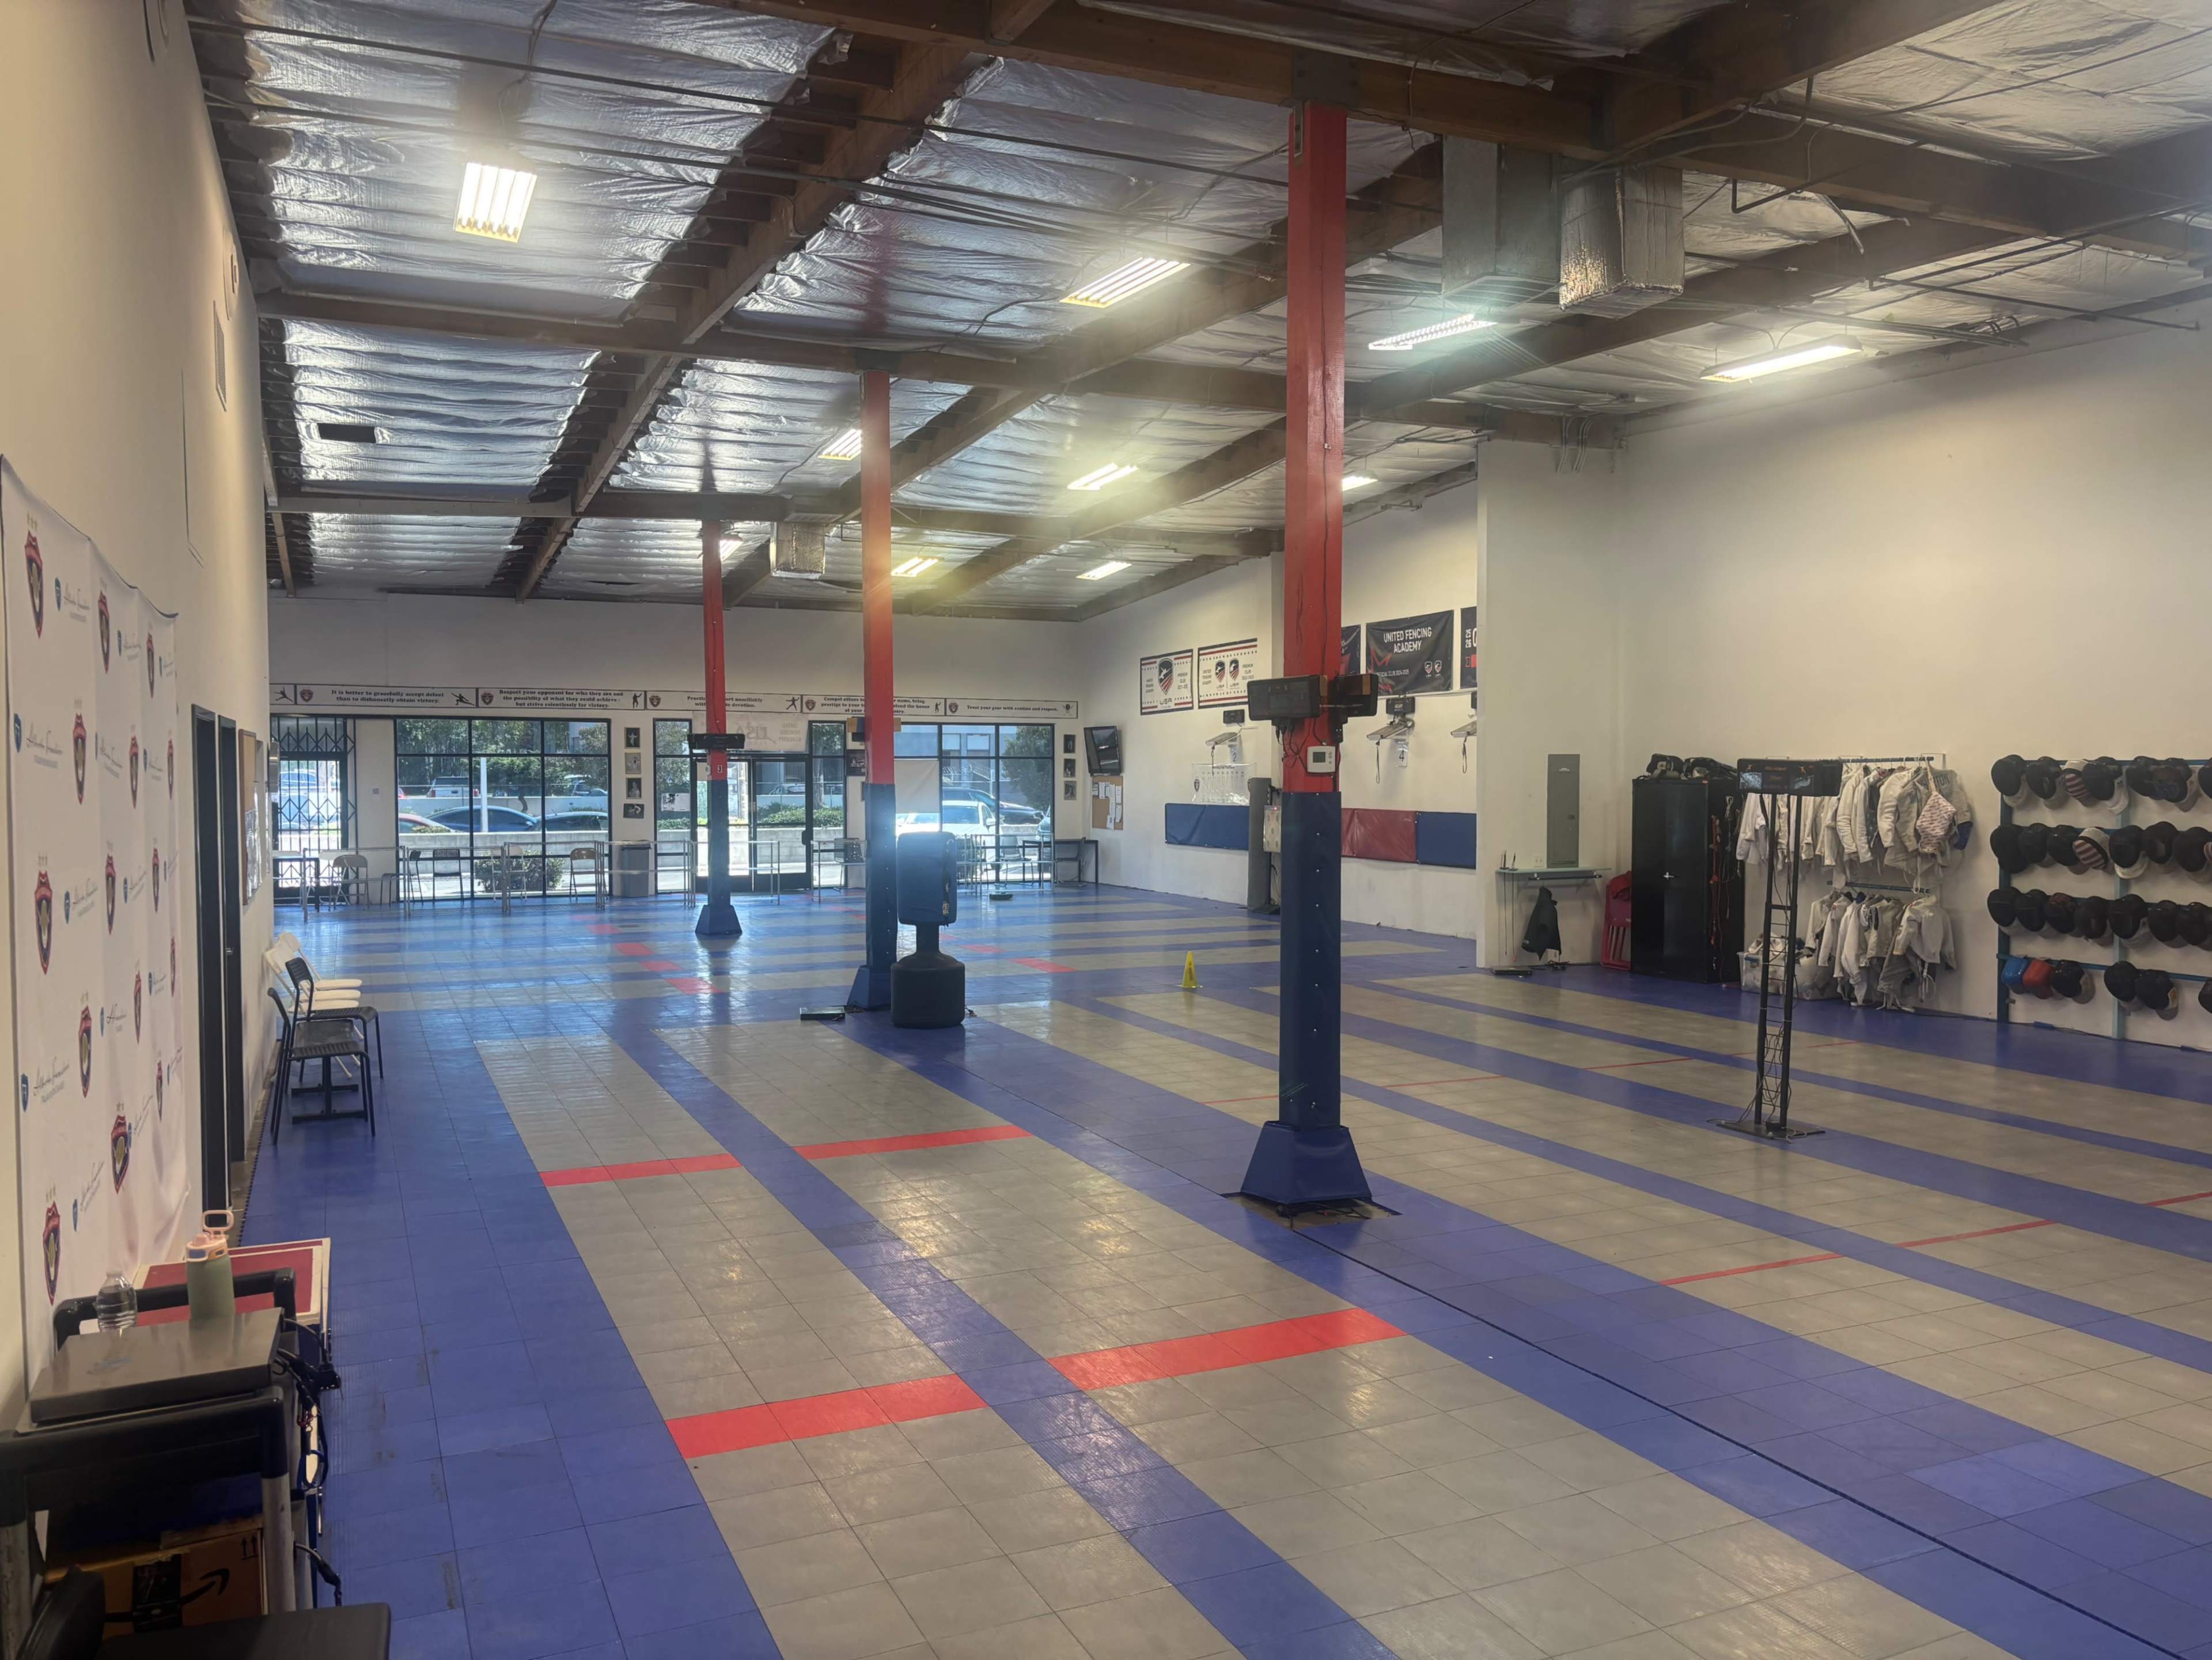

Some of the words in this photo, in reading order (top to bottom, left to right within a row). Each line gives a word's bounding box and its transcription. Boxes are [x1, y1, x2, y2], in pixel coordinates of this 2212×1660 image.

[1383, 630, 1404, 643] UNITED
[1405, 626, 1432, 640] FENCING
[1465, 629, 1471, 638] 25
[1393, 640, 1422, 653] ACADEMY
[1465, 639, 1471, 648] 26
[1233, 752, 1237, 762] 2
[1399, 750, 1404, 762] 4
